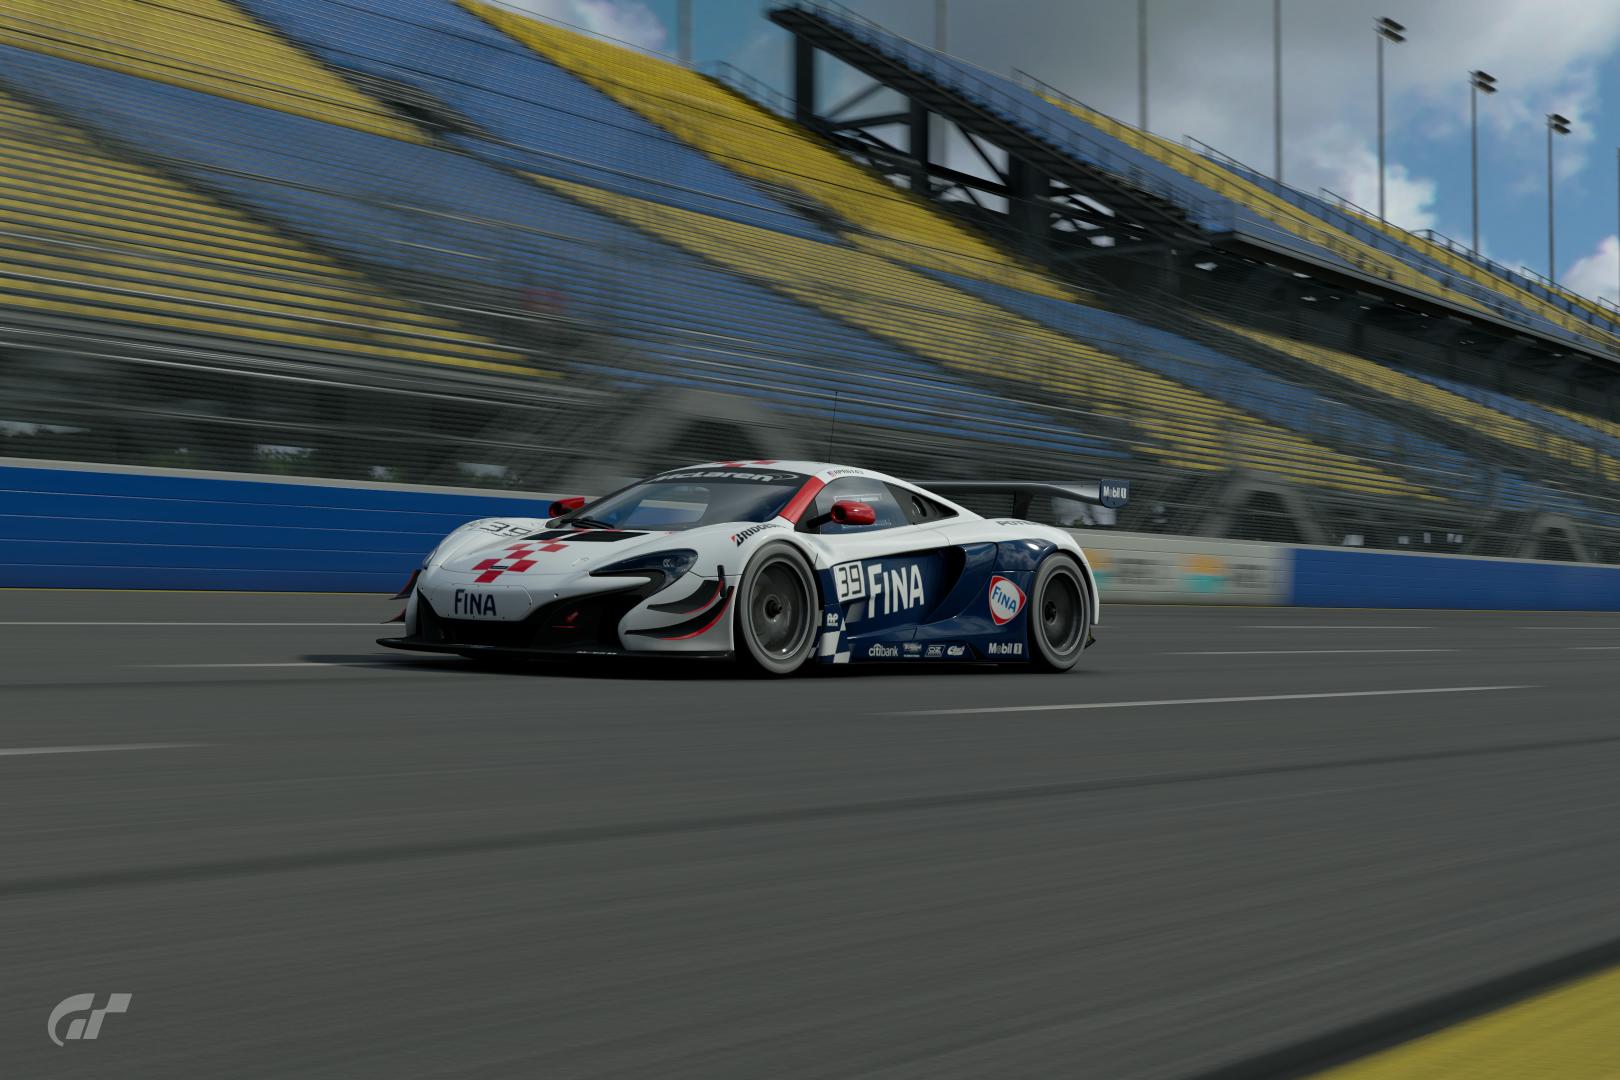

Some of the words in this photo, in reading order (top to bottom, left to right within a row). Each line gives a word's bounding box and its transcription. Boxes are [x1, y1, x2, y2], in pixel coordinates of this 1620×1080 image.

[1103, 485, 1120, 498] Mobil
[838, 564, 862, 598] 39
[867, 563, 925, 619] FINA
[992, 586, 1017, 613] FINA
[454, 589, 497, 616] FINA
[868, 643, 898, 657] citibank
[988, 642, 1012, 654] Mobil
